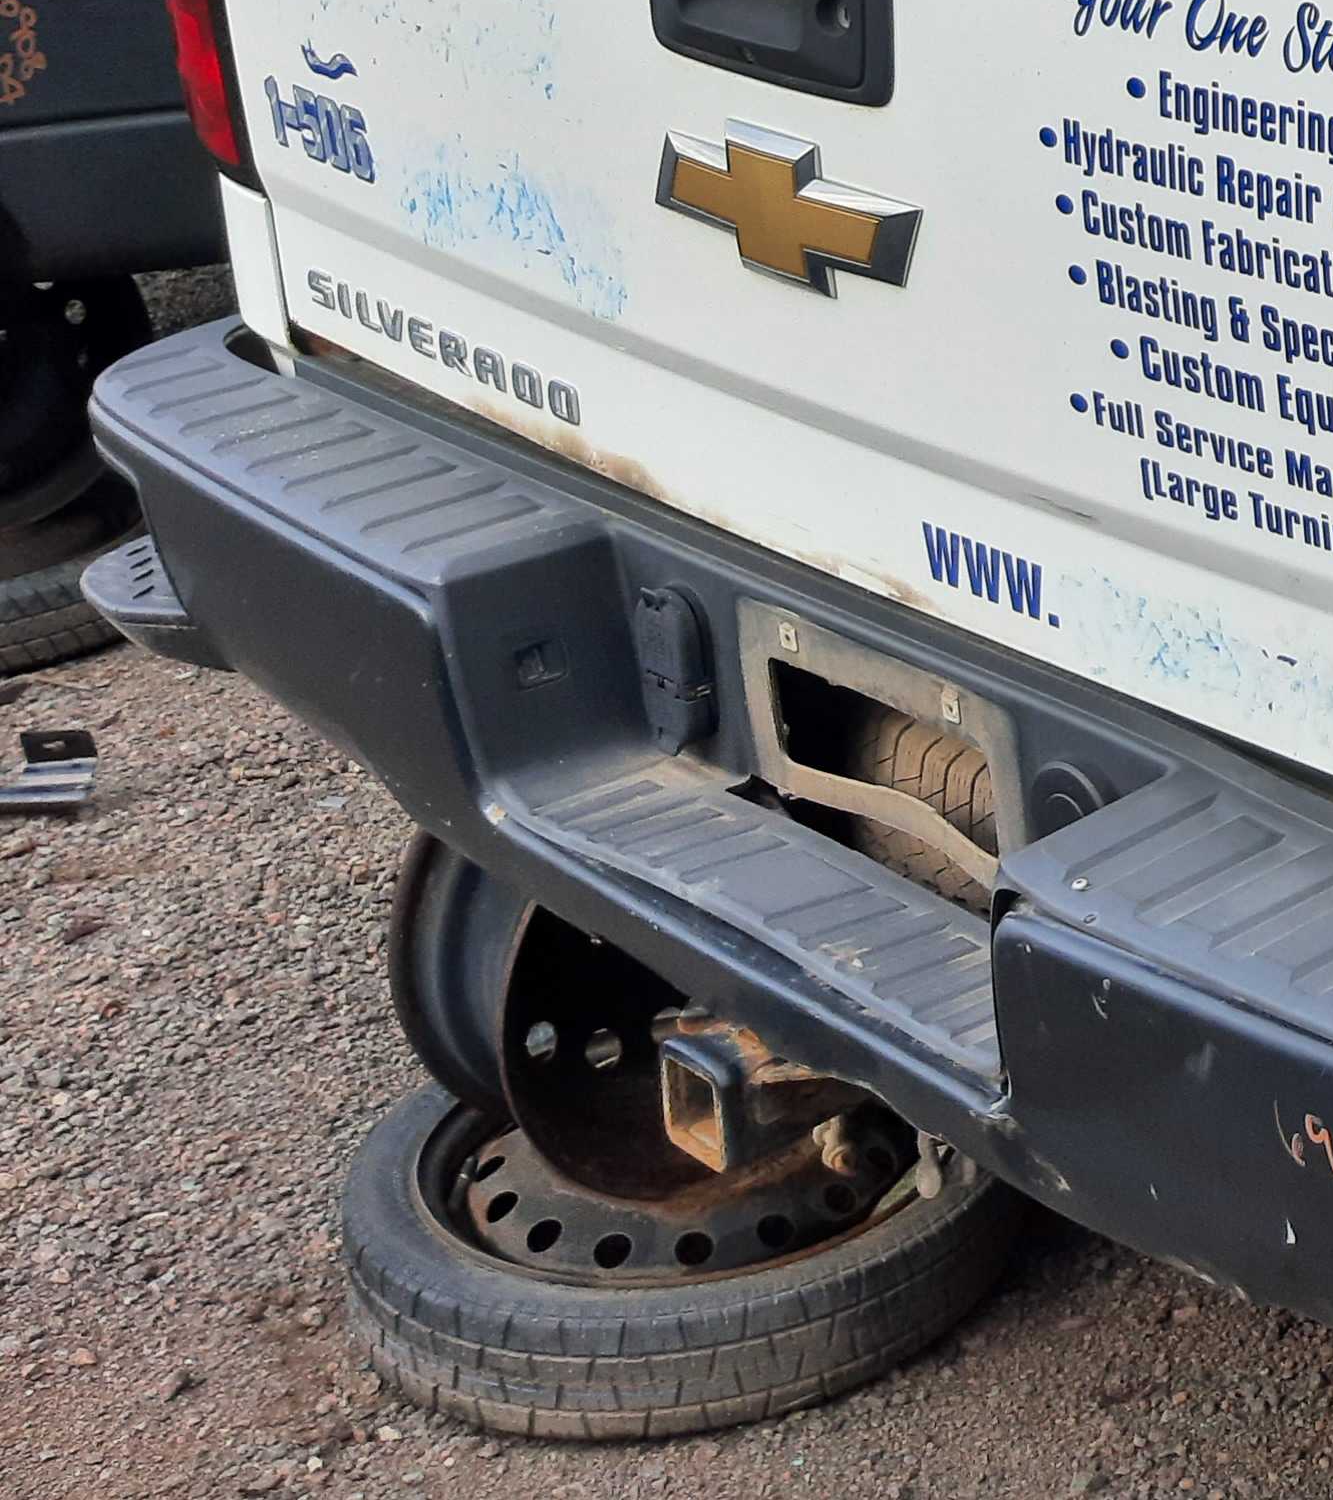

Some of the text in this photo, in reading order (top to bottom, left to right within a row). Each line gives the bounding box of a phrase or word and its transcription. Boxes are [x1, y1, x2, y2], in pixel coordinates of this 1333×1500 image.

[1063, 118, 1204, 197] Hydraulic
[1216, 155, 1321, 224] Repair
[1081, 189, 1191, 260] Custom
[1096, 259, 1218, 341] Blasting
[1230, 297, 1250, 342] &
[307, 268, 581, 426] SILVERADO
[1140, 336, 1264, 413] Custom
[1093, 390, 1143, 440] Full
[1155, 409, 1273, 479] Service
[921, 521, 1060, 628] WWW.
